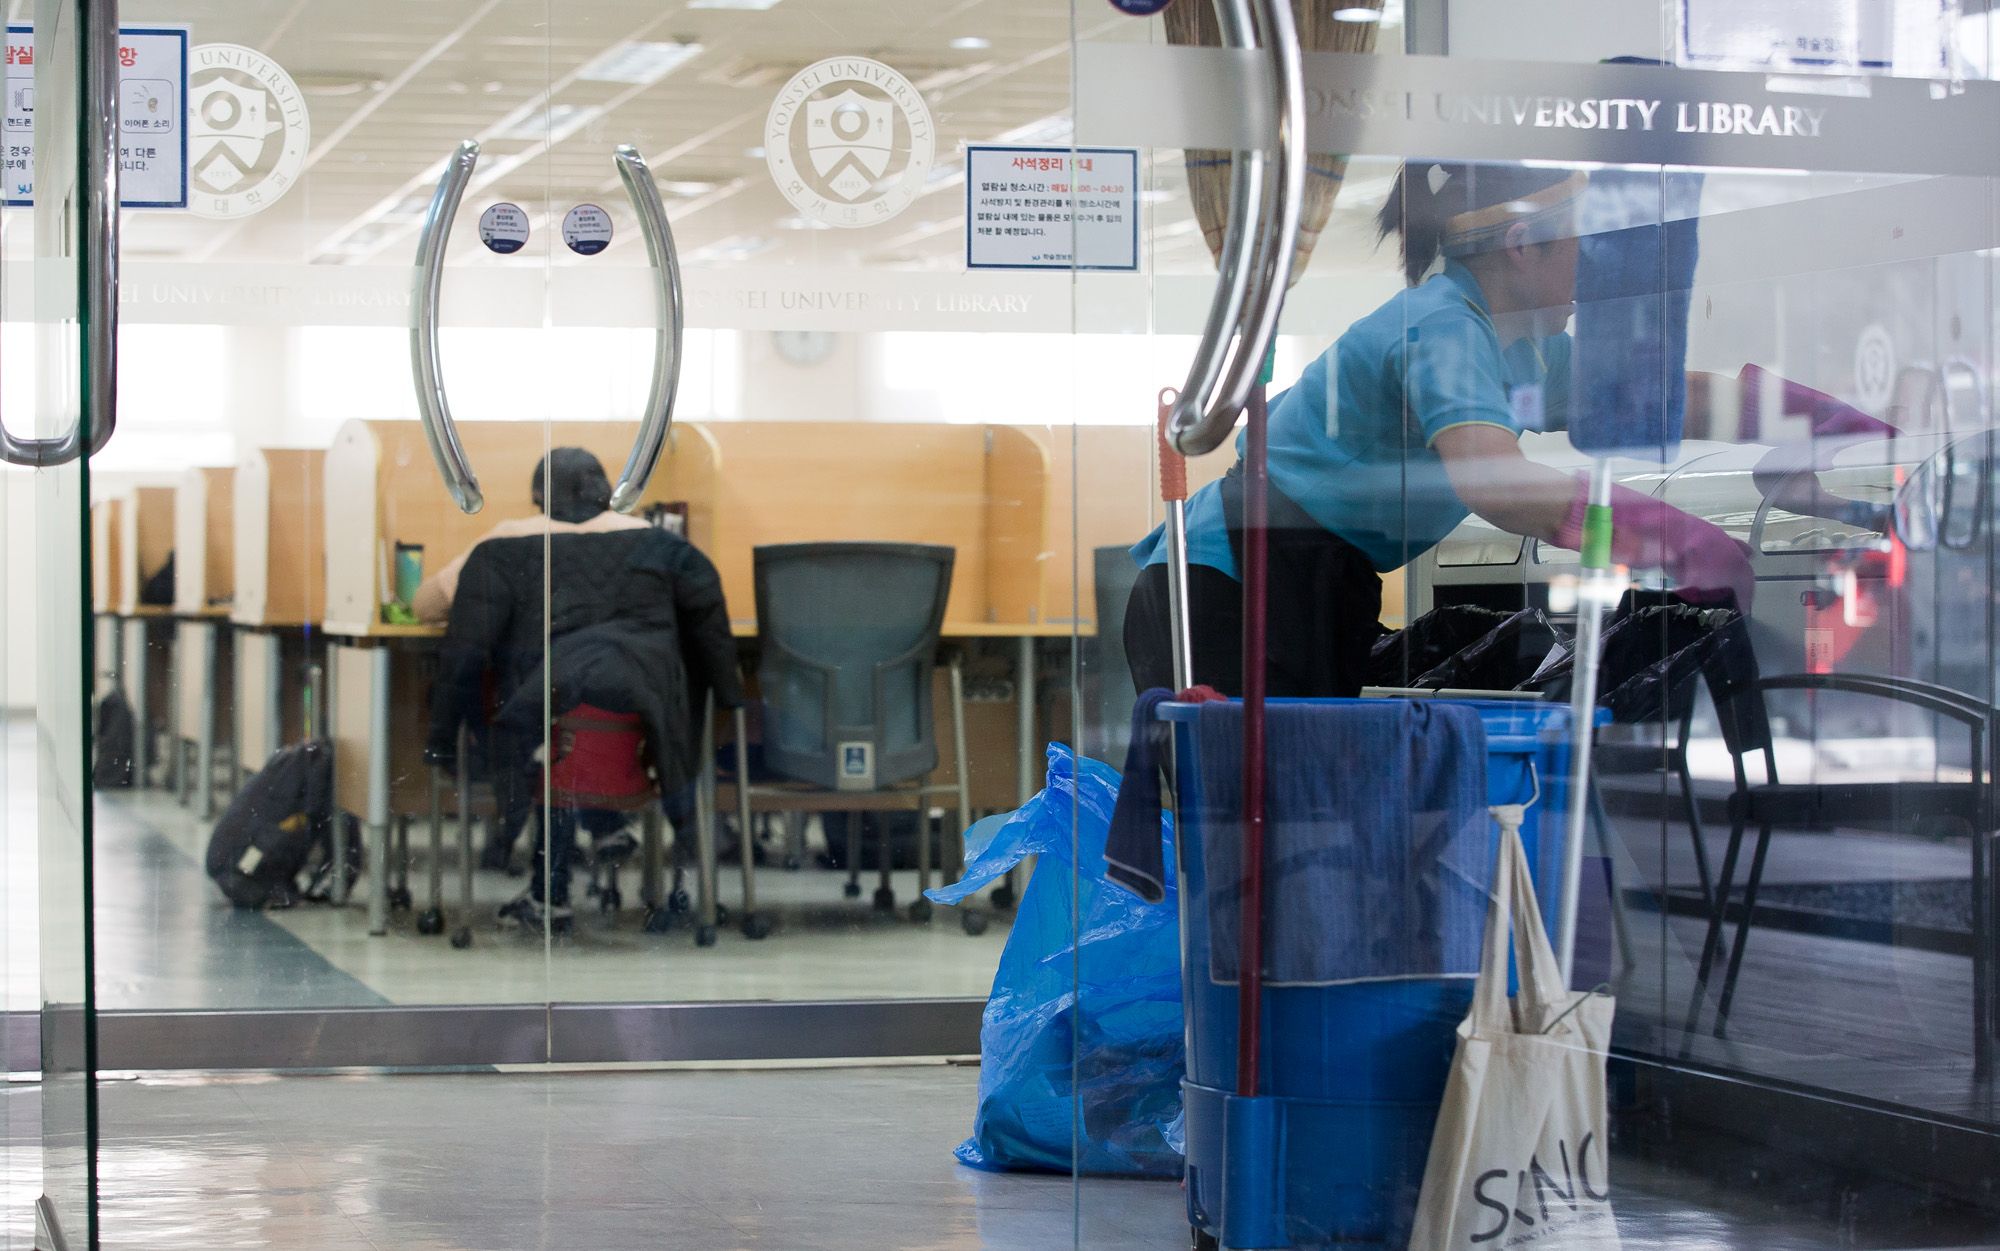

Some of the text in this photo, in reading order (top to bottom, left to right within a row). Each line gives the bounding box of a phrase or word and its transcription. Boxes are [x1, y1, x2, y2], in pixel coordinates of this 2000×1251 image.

[772, 63, 929, 142] YONSEI UNIVERSITY
[124, 119, 170, 128] 이어폰 소리
[1434, 93, 1660, 131] UNIVERSITY
[1676, 101, 1828, 138] LIBRARY
[135, 147, 156, 158] 다른
[1011, 157, 1063, 171] 사석정리
[935, 292, 1033, 313] LIBRARY
